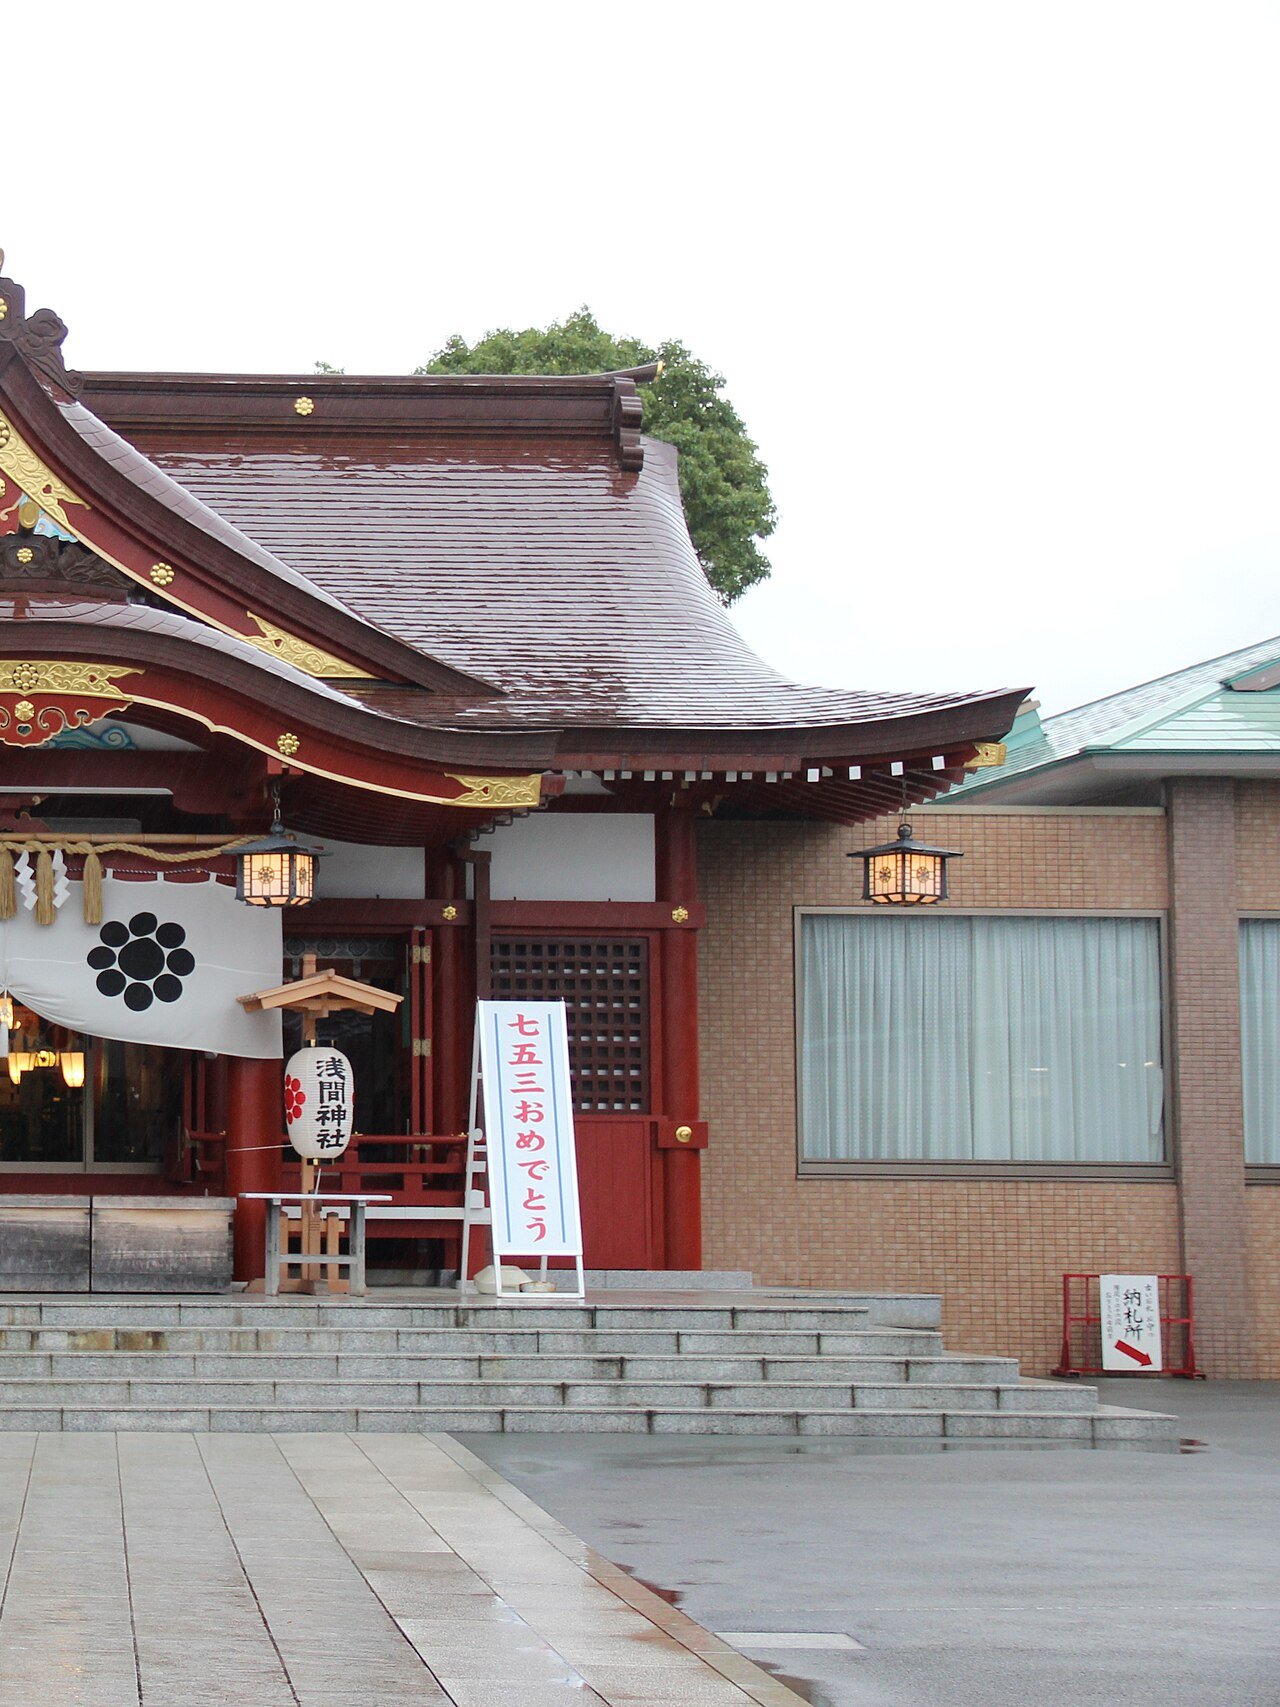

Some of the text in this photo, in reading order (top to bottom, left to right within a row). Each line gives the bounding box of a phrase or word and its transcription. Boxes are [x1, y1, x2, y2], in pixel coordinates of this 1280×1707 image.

[315, 1056, 347, 1149] 浅間神社
[507, 1013, 550, 1242] 七五三おめでとう
[1122, 1288, 1143, 1341] 納札所
